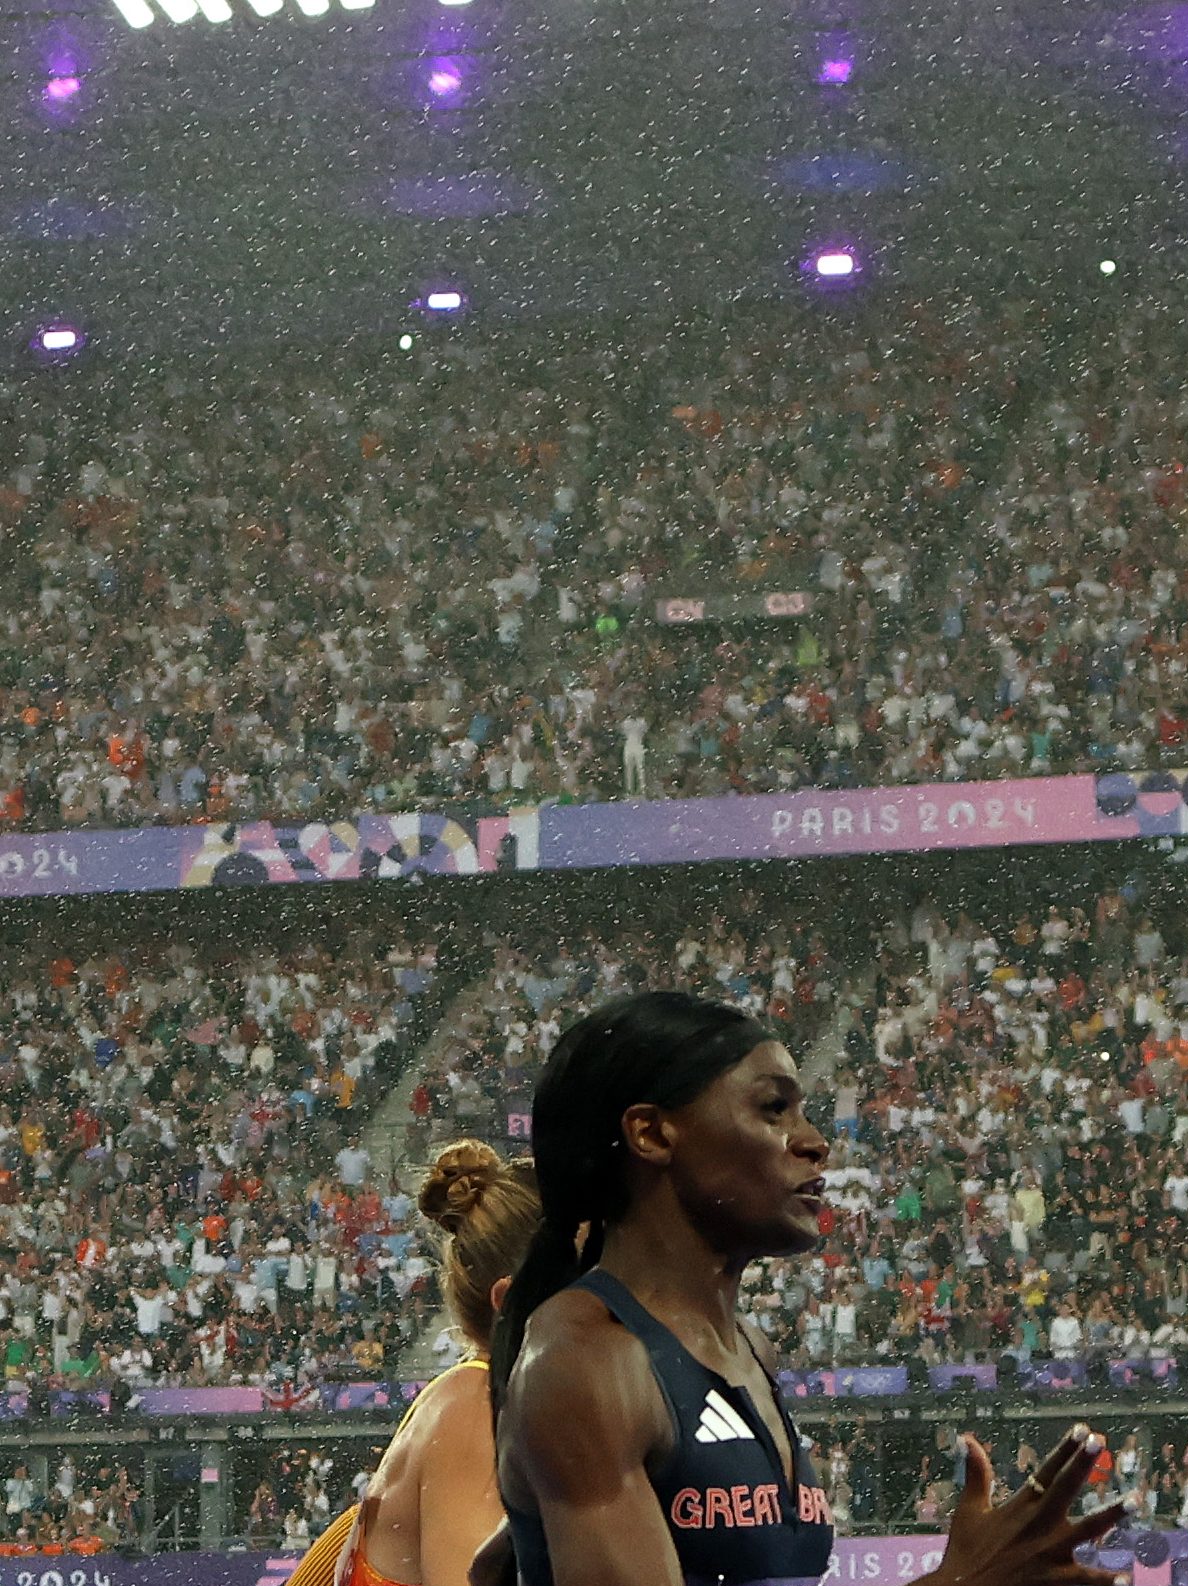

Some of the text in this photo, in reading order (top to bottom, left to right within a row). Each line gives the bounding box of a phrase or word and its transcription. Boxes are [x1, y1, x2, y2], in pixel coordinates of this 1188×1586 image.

[771, 798, 1036, 836] PARIS 2024
[671, 1484, 783, 1528] GREAT
